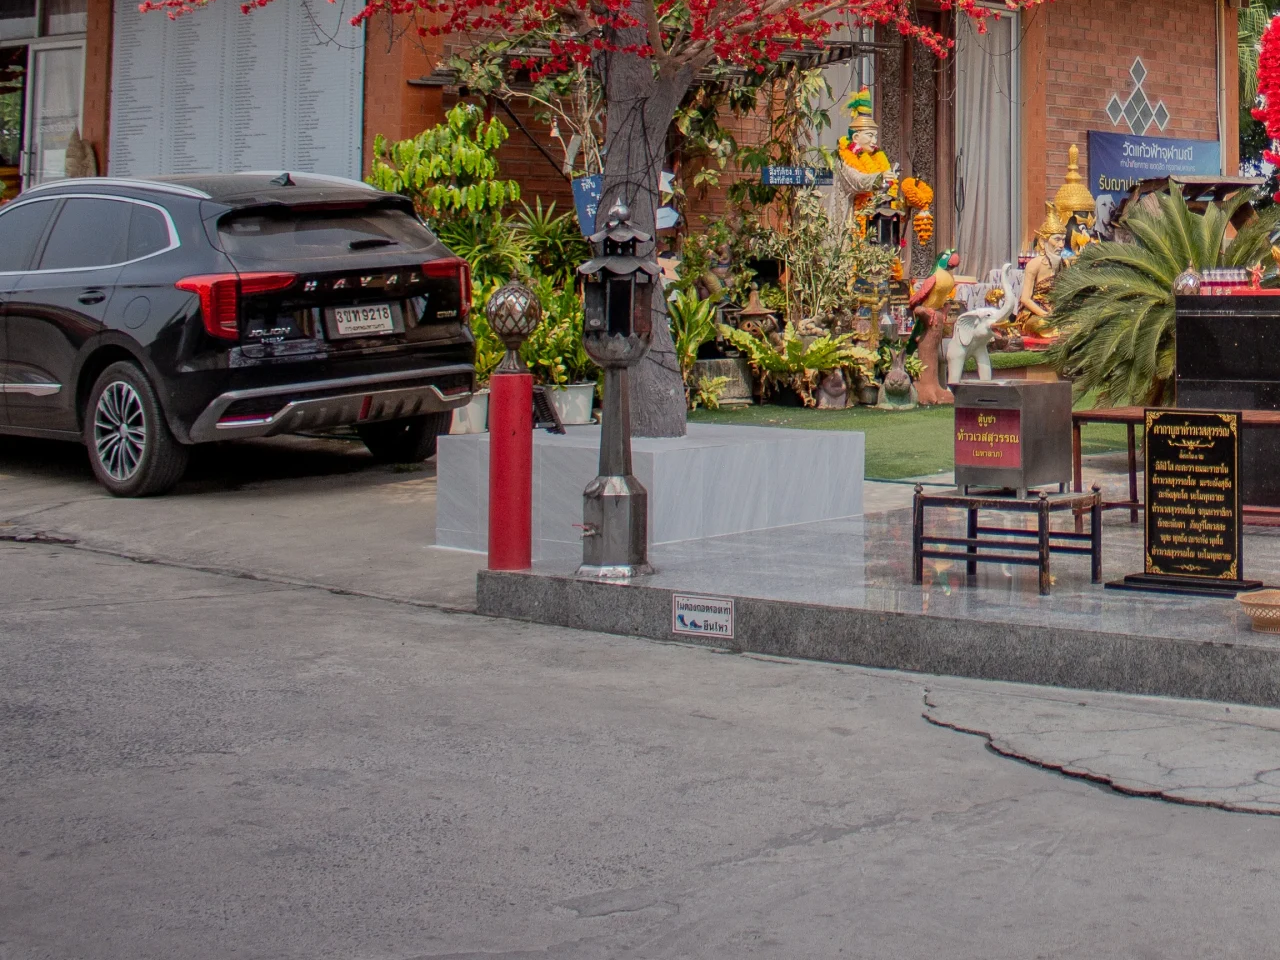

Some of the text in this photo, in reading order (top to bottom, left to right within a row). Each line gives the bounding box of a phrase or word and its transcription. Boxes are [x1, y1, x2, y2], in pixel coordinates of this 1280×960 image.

[1122, 141, 1193, 162] วัดแก้วฟ้าจุฬามณี
[303, 272, 420, 291] HAVAL
[978, 413, 996, 427] ตู้บูชา
[957, 428, 1019, 448] ท้าวเวสสุวรรณ
[676, 598, 731, 615] ไม่ต้องถอดรองเท้า
[703, 619, 729, 633] ยืนไหว้
